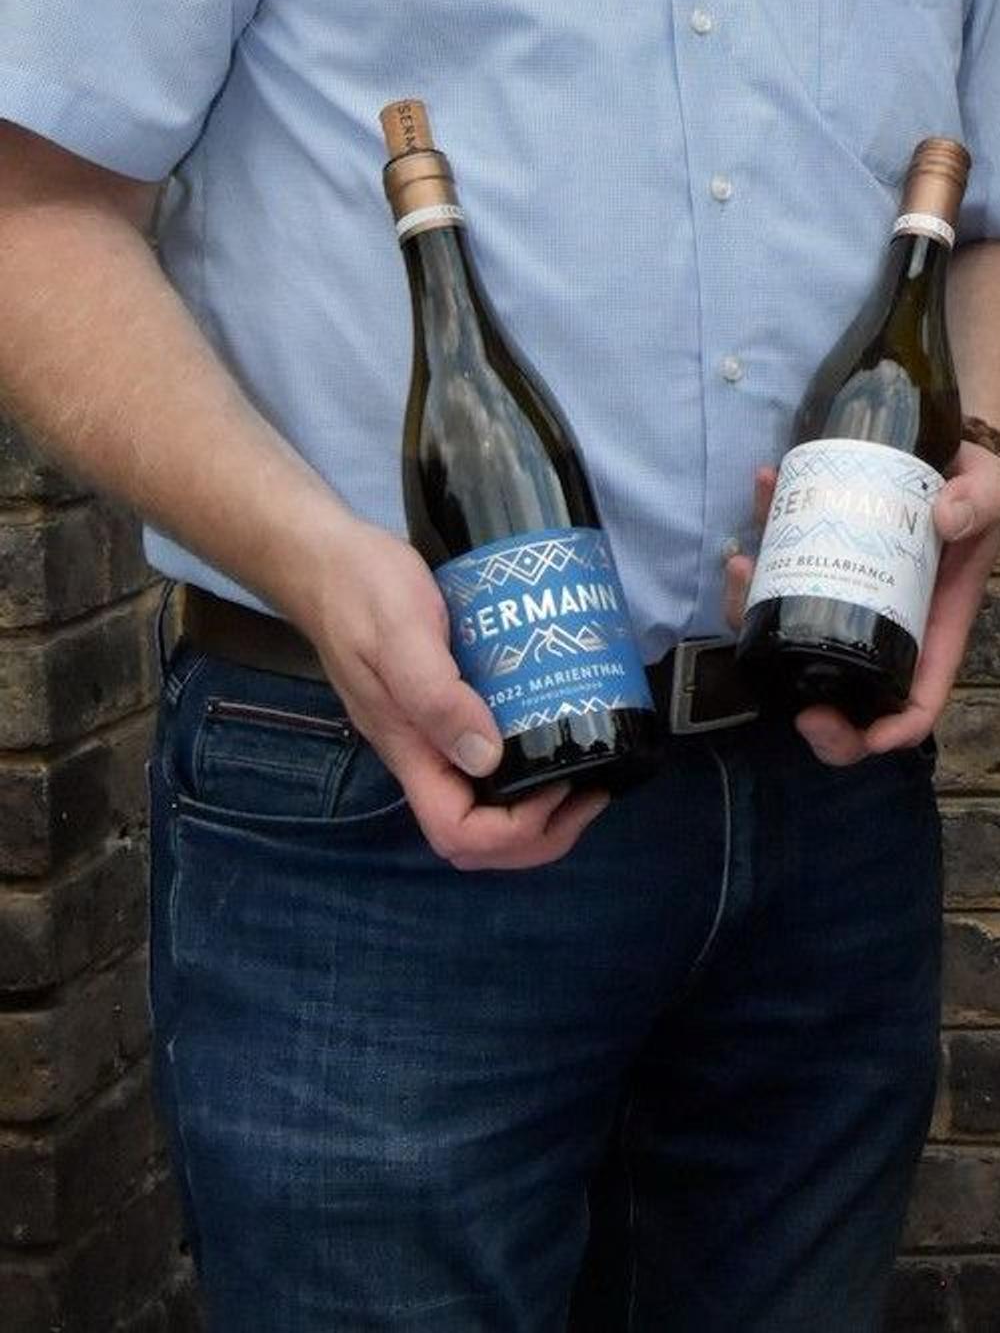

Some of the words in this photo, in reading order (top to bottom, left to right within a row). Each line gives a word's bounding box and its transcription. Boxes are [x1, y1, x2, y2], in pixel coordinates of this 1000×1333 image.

[461, 582, 618, 645] SERMANN
[487, 684, 524, 707] 2022
[528, 663, 625, 692] MARIENTHAL
